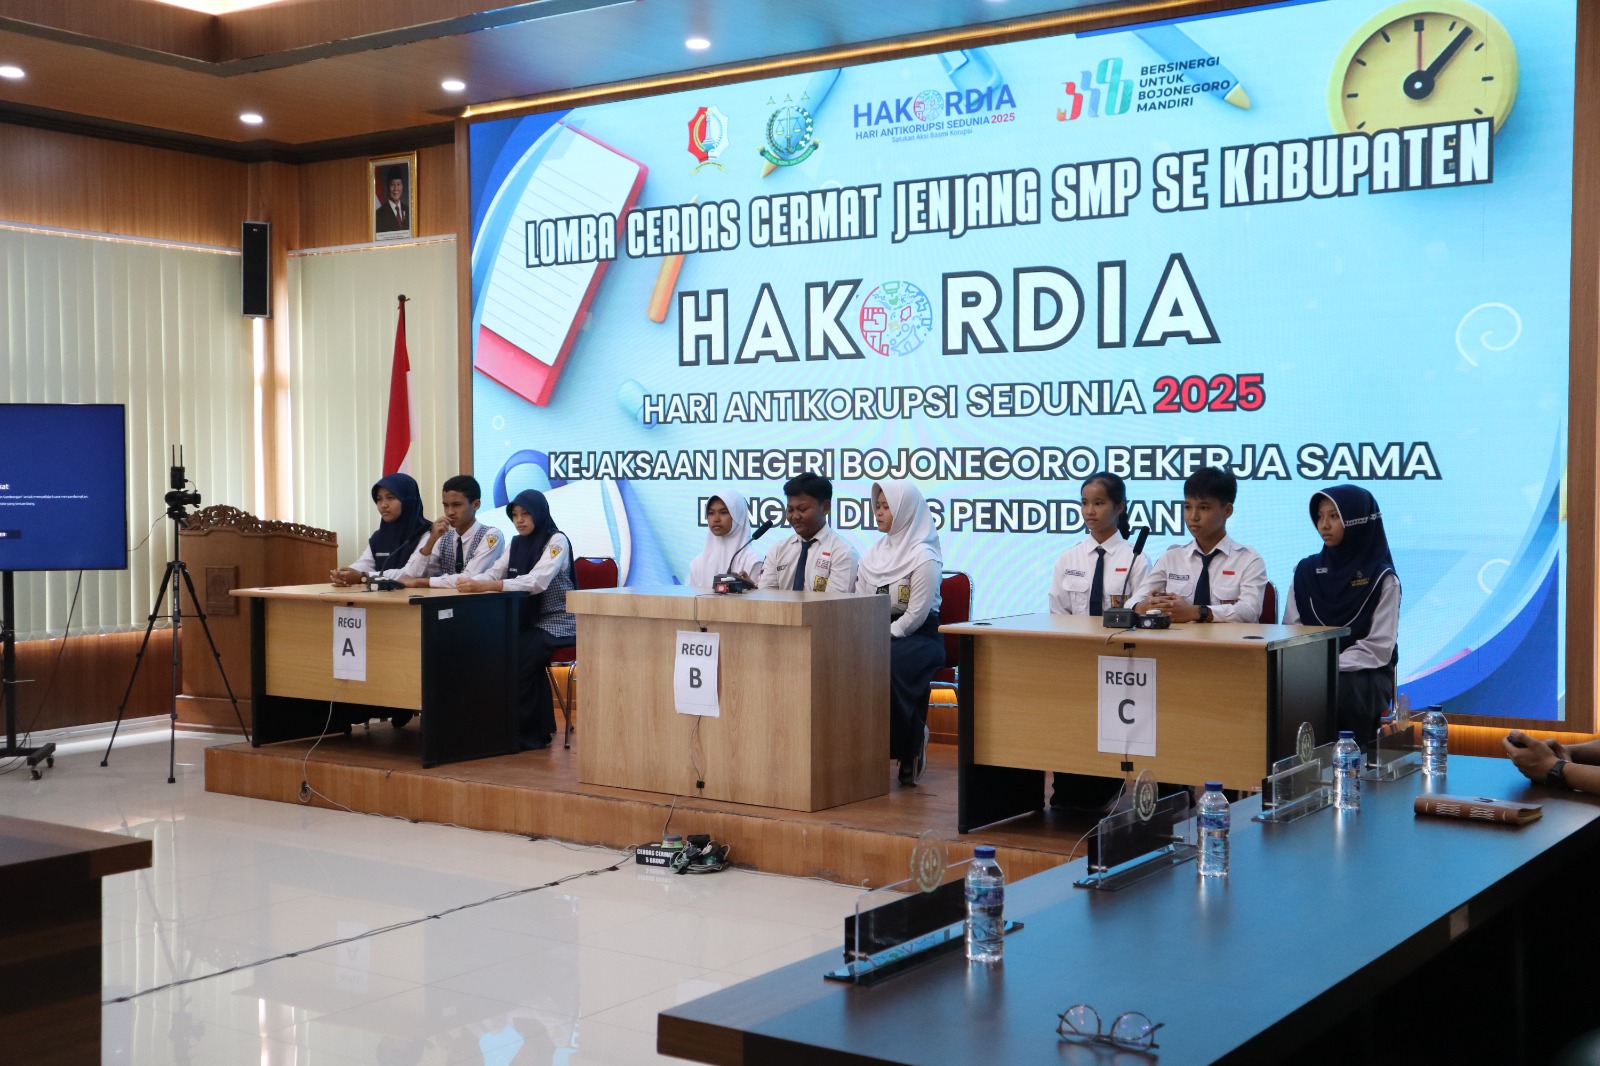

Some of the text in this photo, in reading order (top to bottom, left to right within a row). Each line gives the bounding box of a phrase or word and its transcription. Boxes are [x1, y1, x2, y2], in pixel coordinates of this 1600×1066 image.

[1140, 56, 1220, 76] BERSINERGI
[1138, 80, 1230, 100] BOJONEGORO
[1139, 73, 1184, 88] UNTUK
[1137, 97, 1193, 112] MANDIRI
[855, 113, 1015, 140] HARI ANTIKORUPSI SEDUNIA 2025
[916, 133, 929, 141] Aksi
[930, 131, 949, 139] Basmi
[950, 128, 973, 138] Korupsi
[525, 117, 1494, 268] LOMBA CERDAS CERMAT JENJANG SMP SE KABUPATEN
[642, 373, 1266, 425] HARI ANTIKORUPSI SEDUNIA 2025
[548, 442, 1442, 480] KEJAKSAAN NEGERI BOJONEGORO BEKERJA SAMA
[338, 617, 361, 629] REGU
[342, 638, 355, 657] A
[681, 643, 712, 657] REGU
[689, 667, 702, 688] B
[1105, 671, 1147, 687] REGU
[1118, 699, 1135, 724] C
